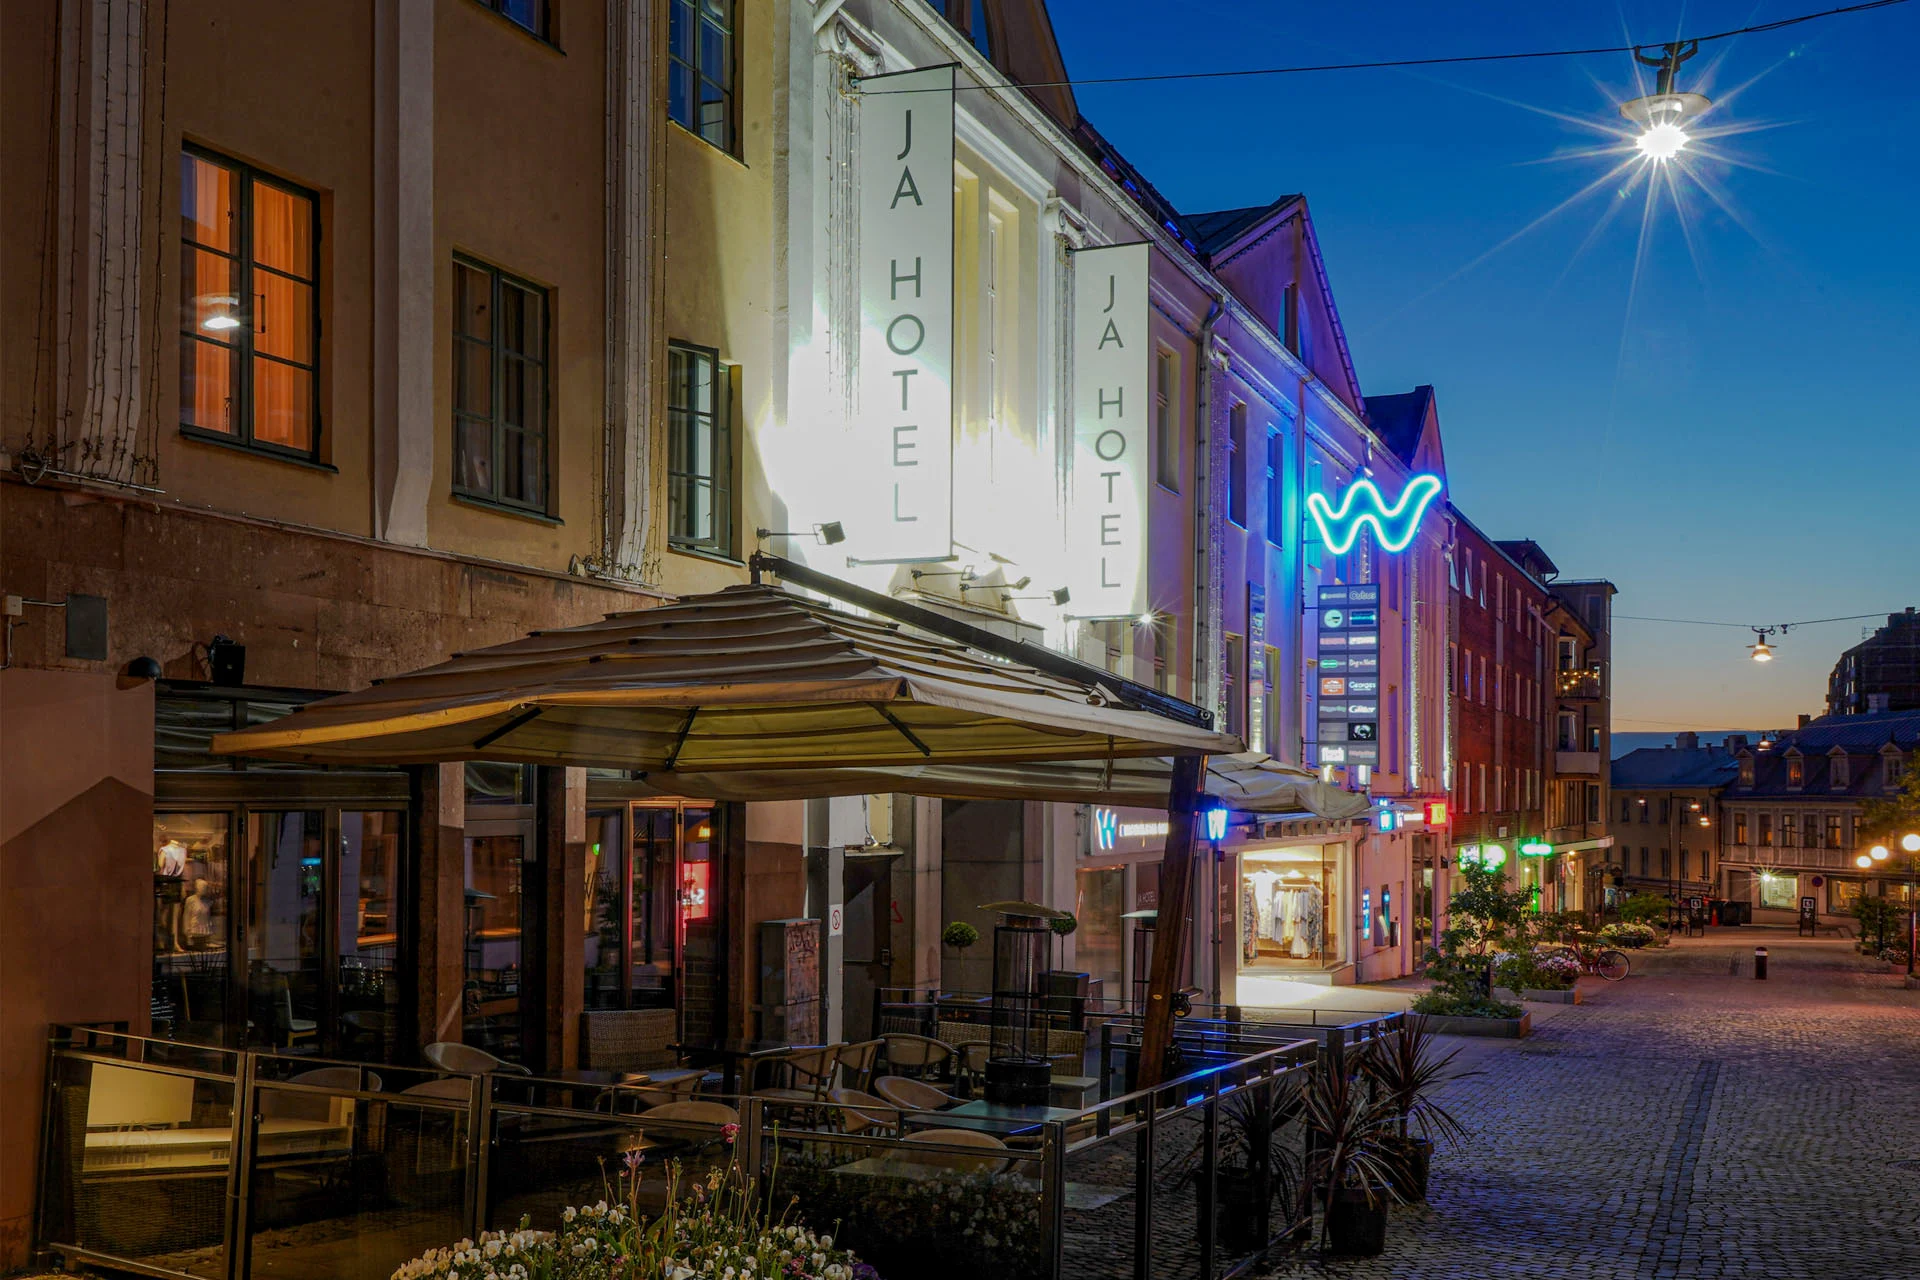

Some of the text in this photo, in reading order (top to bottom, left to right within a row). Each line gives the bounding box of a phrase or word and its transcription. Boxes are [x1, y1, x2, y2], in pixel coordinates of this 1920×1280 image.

[885, 109, 926, 523] JA HOTEL
[1095, 274, 1127, 588] JA HOTEL
[1348, 704, 1377, 713] Glitter
